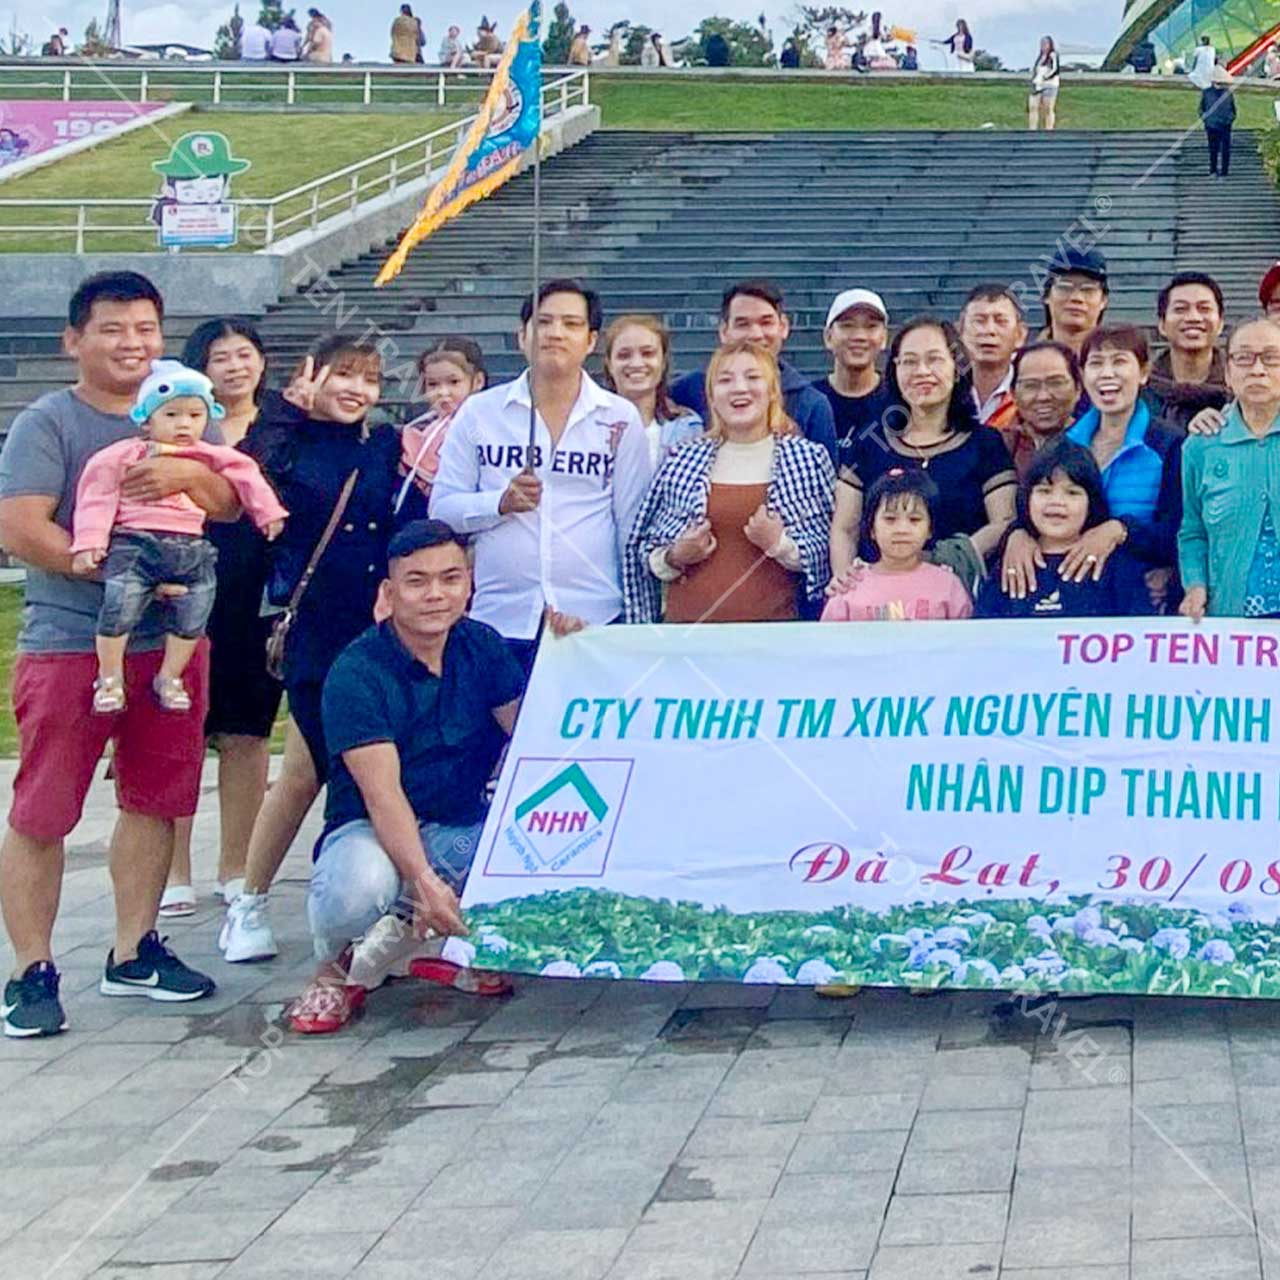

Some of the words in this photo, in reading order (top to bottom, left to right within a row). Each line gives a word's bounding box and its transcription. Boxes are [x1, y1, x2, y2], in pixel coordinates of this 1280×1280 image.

[1057, 633, 1134, 665] TOP
[1145, 633, 1220, 666] TEN
[560, 697, 643, 739] CTY
[653, 697, 764, 739] TNHH
[777, 698, 837, 739] TM
[843, 695, 935, 738] XNK
[1125, 690, 1271, 743] HUỲNH
[906, 757, 1024, 814] NHÂN
[1038, 766, 1107, 821] DỊP
[1120, 763, 1262, 821] THÀNH
[527, 810, 588, 836] NHN
[789, 841, 890, 884] Đà
[919, 844, 1061, 895] Lạt,
